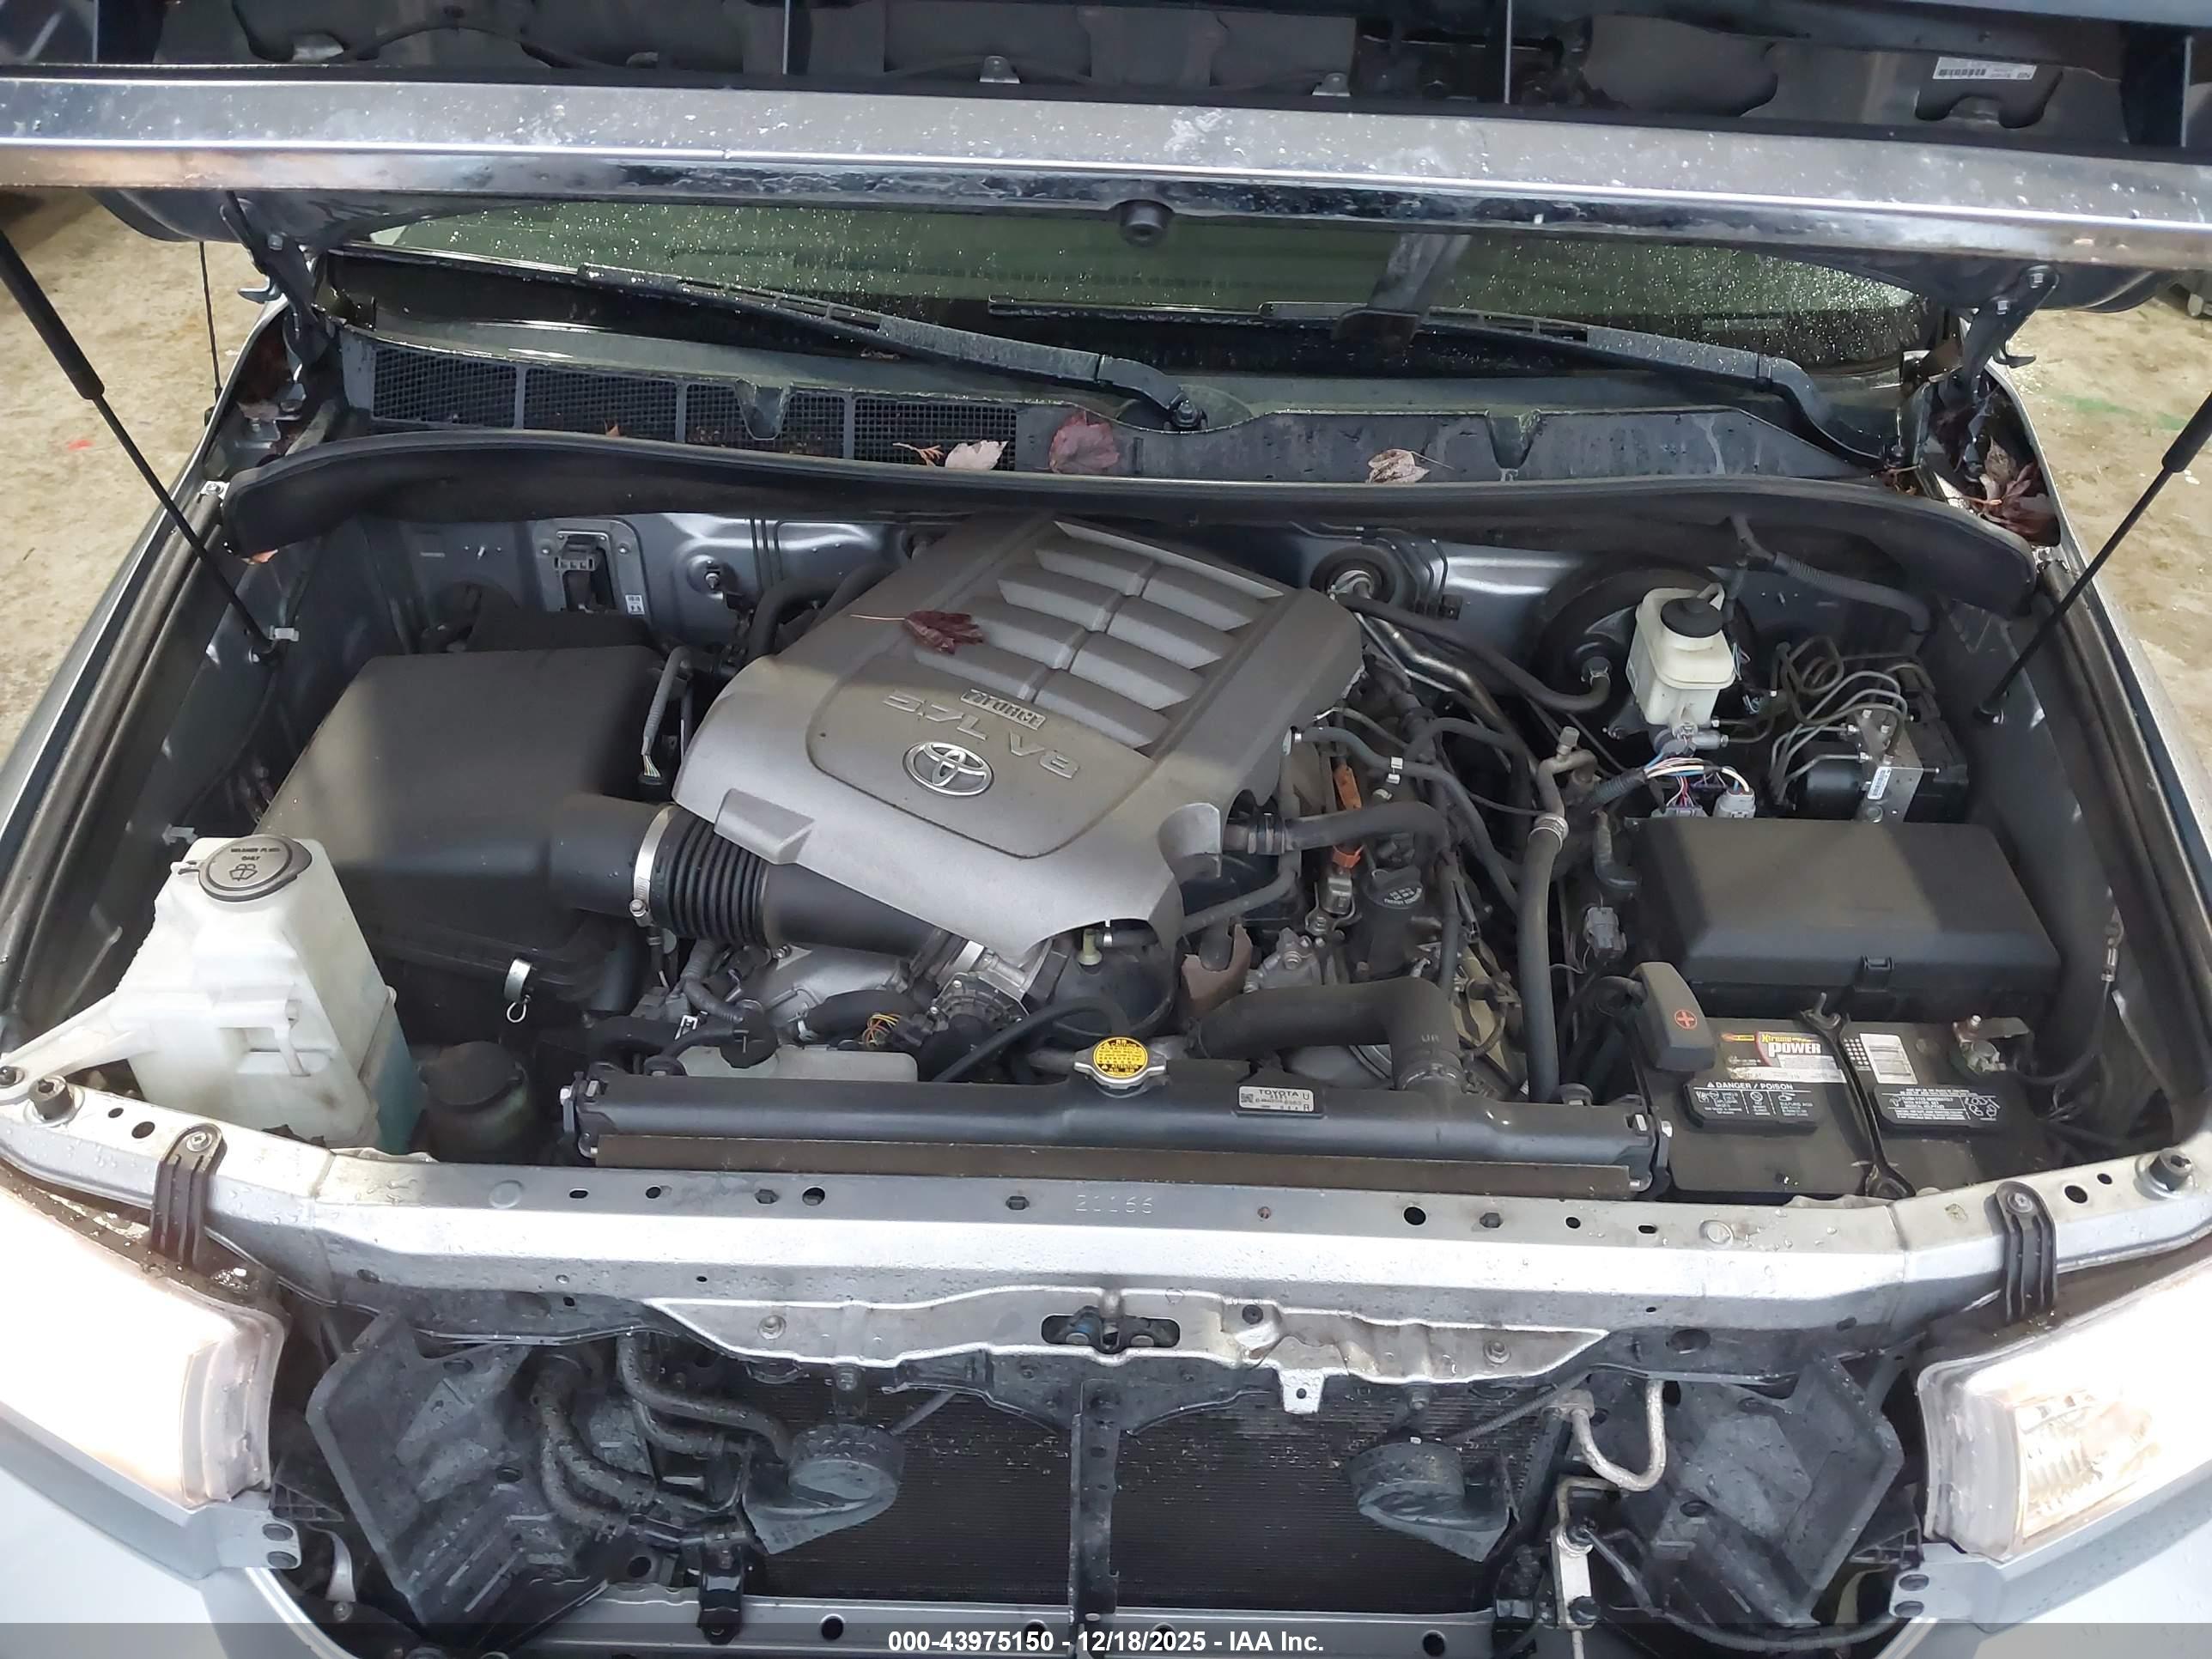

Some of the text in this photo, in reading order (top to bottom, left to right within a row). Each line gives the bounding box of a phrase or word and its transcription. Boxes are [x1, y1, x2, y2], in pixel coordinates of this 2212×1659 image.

[883, 690, 1079, 779] 5.7L V8
[1768, 1042, 1821, 1057] POWER
[1259, 1089, 1299, 1097] TOYOTA
